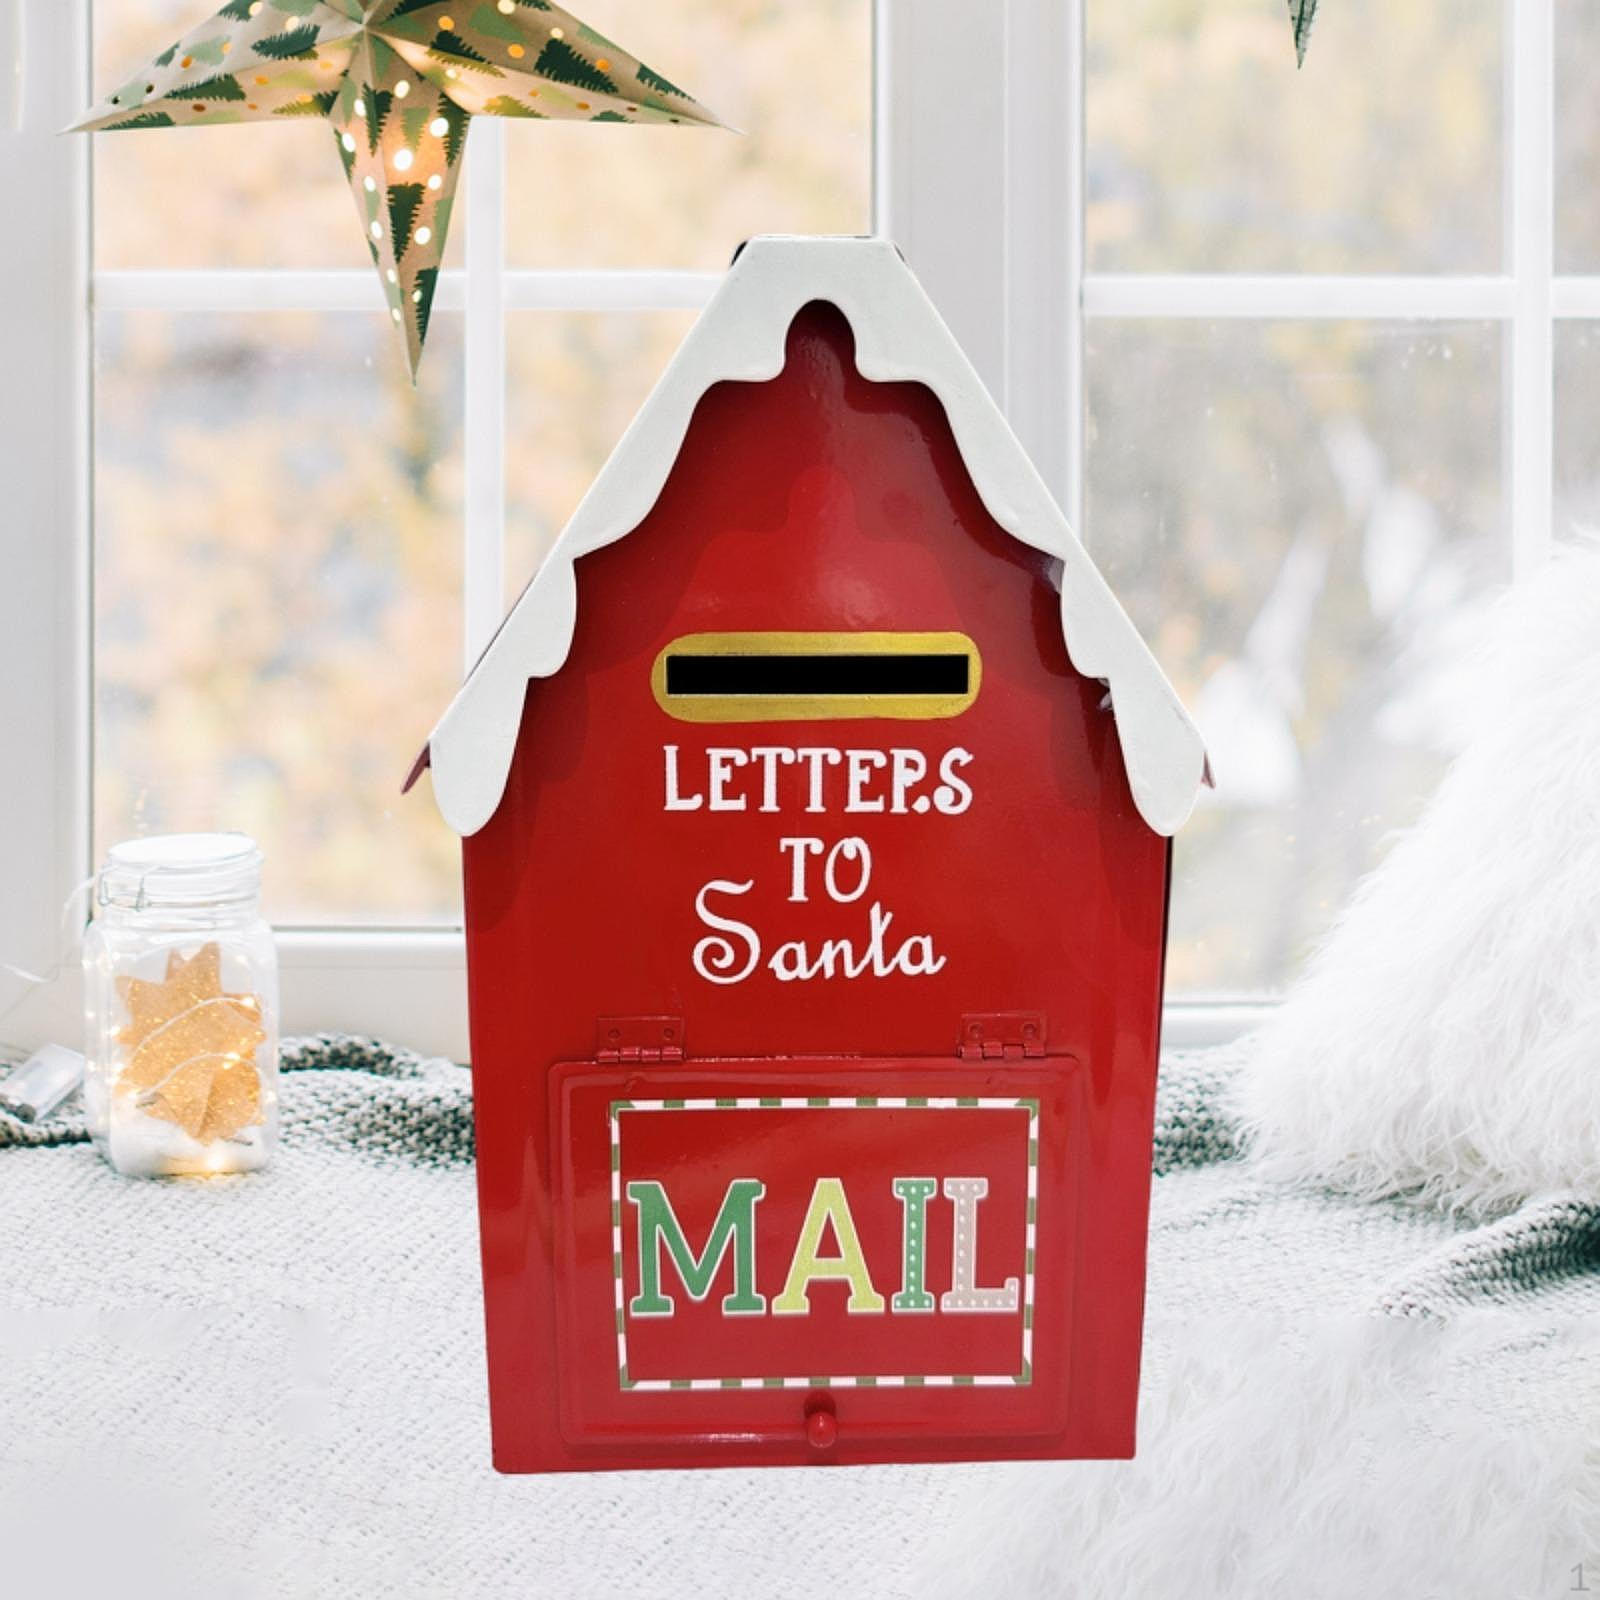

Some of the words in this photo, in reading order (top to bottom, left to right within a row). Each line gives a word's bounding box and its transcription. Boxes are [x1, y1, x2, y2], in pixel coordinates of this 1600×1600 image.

[779, 836, 872, 903] TO
[692, 879, 947, 984] Santa
[626, 1177, 1019, 1317] MAIL
